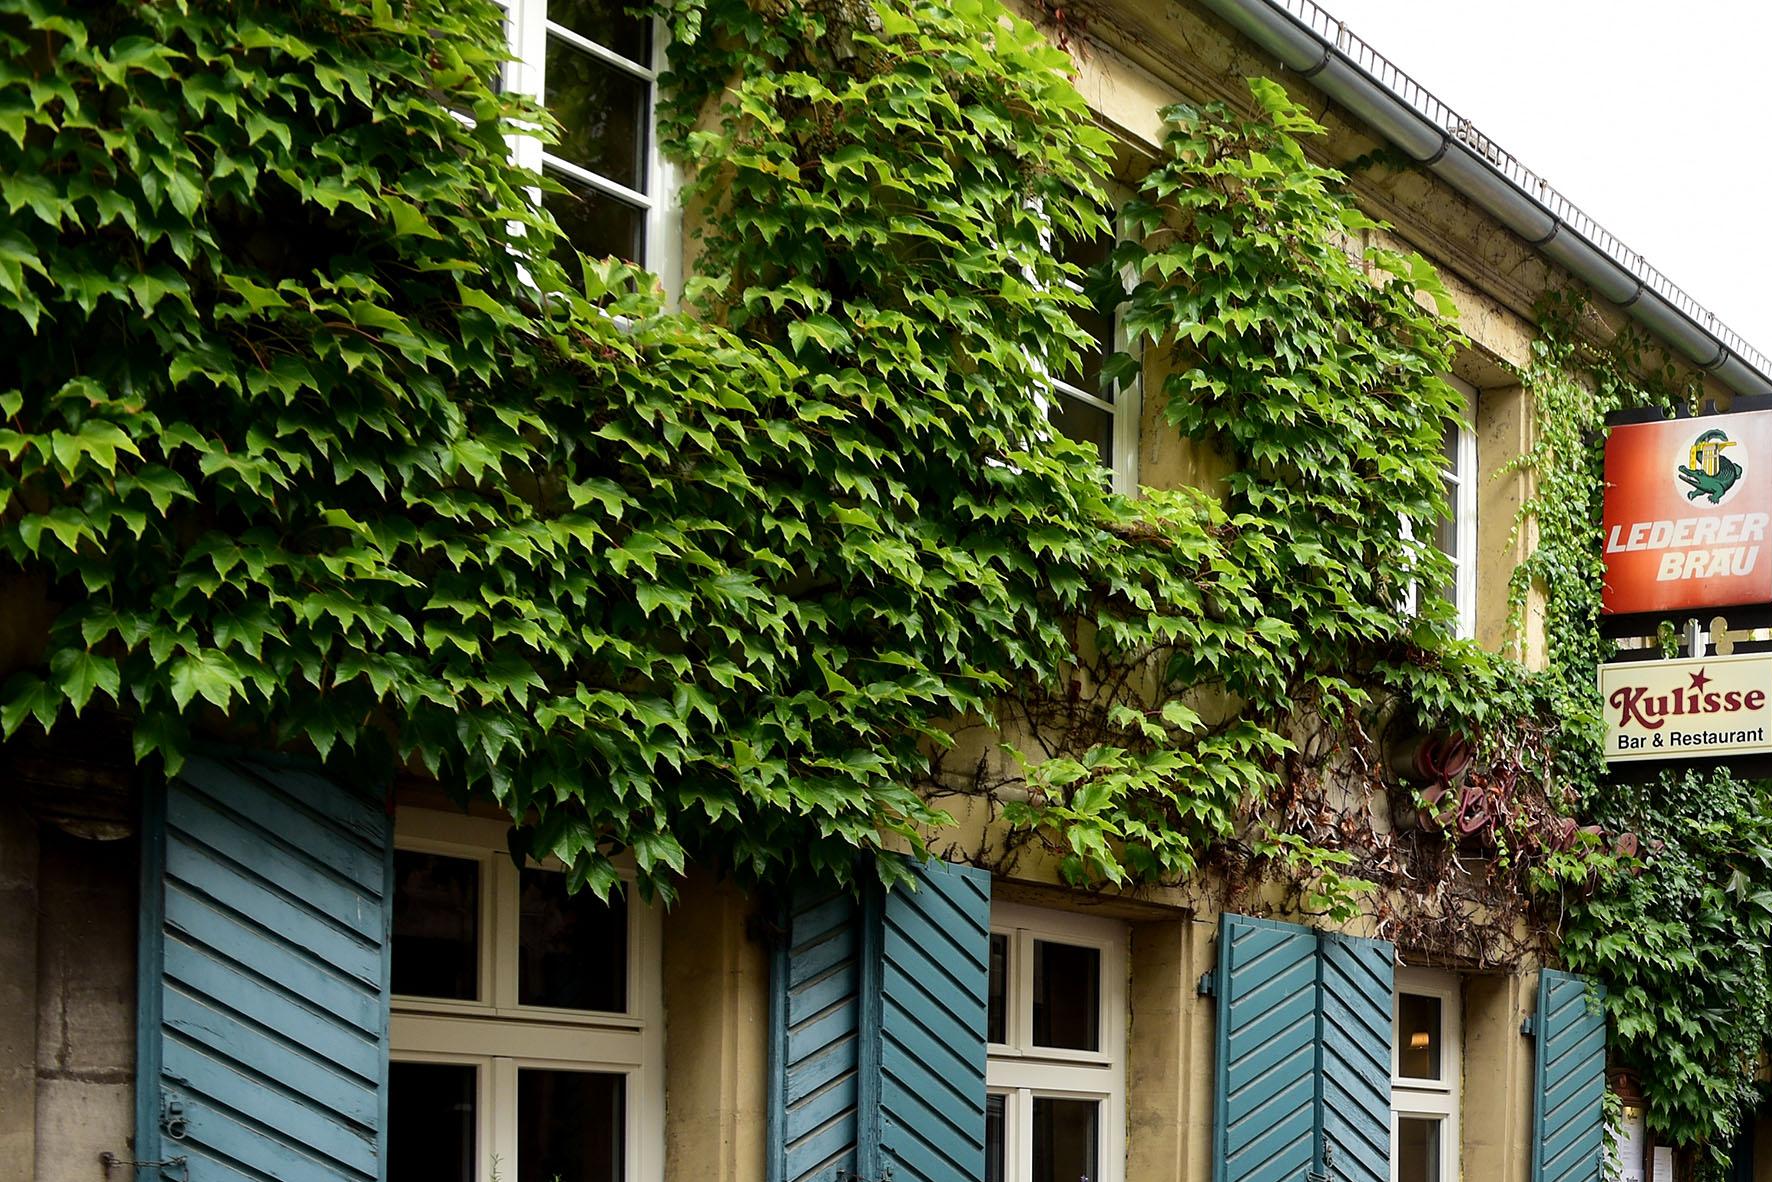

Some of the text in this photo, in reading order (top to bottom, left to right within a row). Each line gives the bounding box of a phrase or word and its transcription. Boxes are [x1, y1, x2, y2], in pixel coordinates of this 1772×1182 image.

[1607, 513, 1769, 553] LEDERER
[1610, 667, 1765, 729] Kulisse
[1618, 728, 1764, 749] Bar & Restaurant
